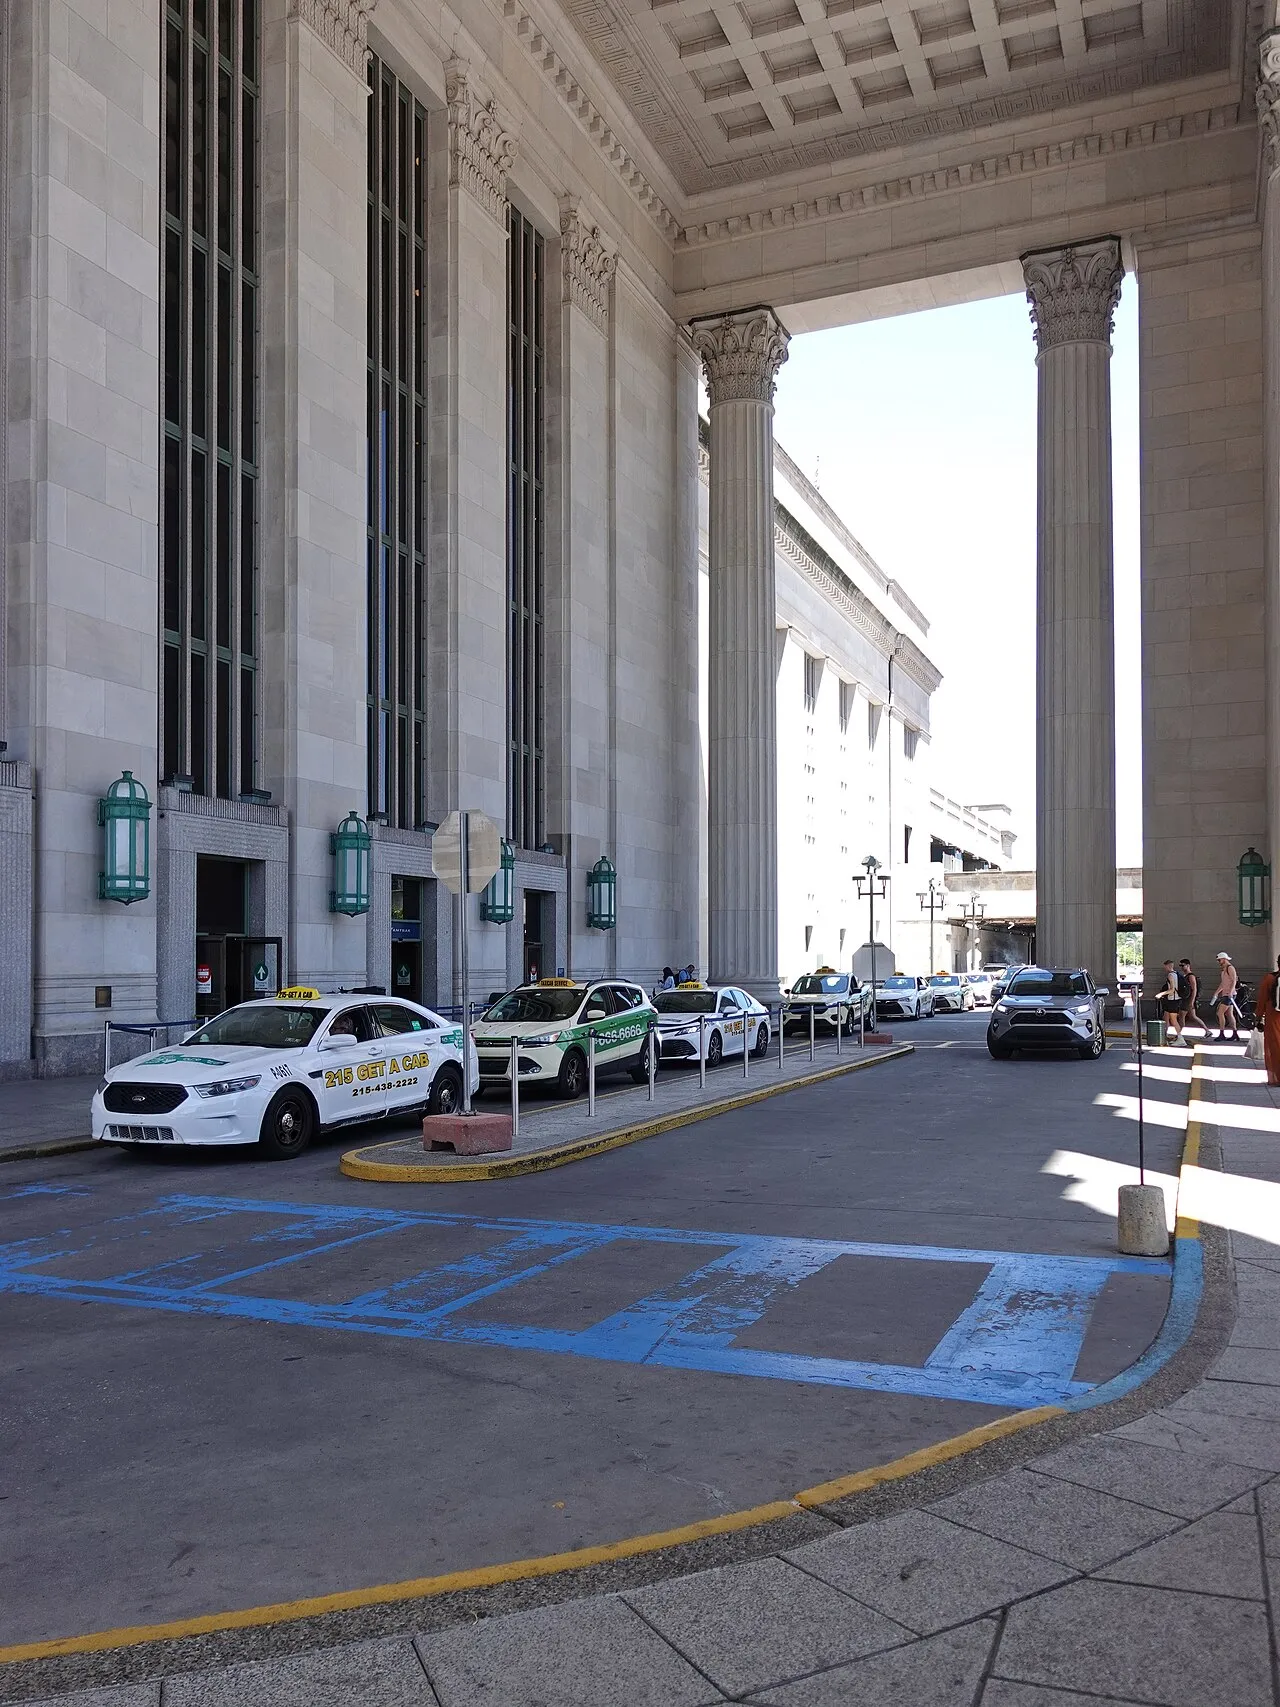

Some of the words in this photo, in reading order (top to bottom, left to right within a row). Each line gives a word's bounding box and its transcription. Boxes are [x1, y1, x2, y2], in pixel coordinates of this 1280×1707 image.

[325, 1067, 354, 1088] 215
[356, 1060, 386, 1081] GET
[389, 1058, 401, 1075] A
[402, 1052, 430, 1071] CAB
[352, 1077, 418, 1097] 215-438-2222
